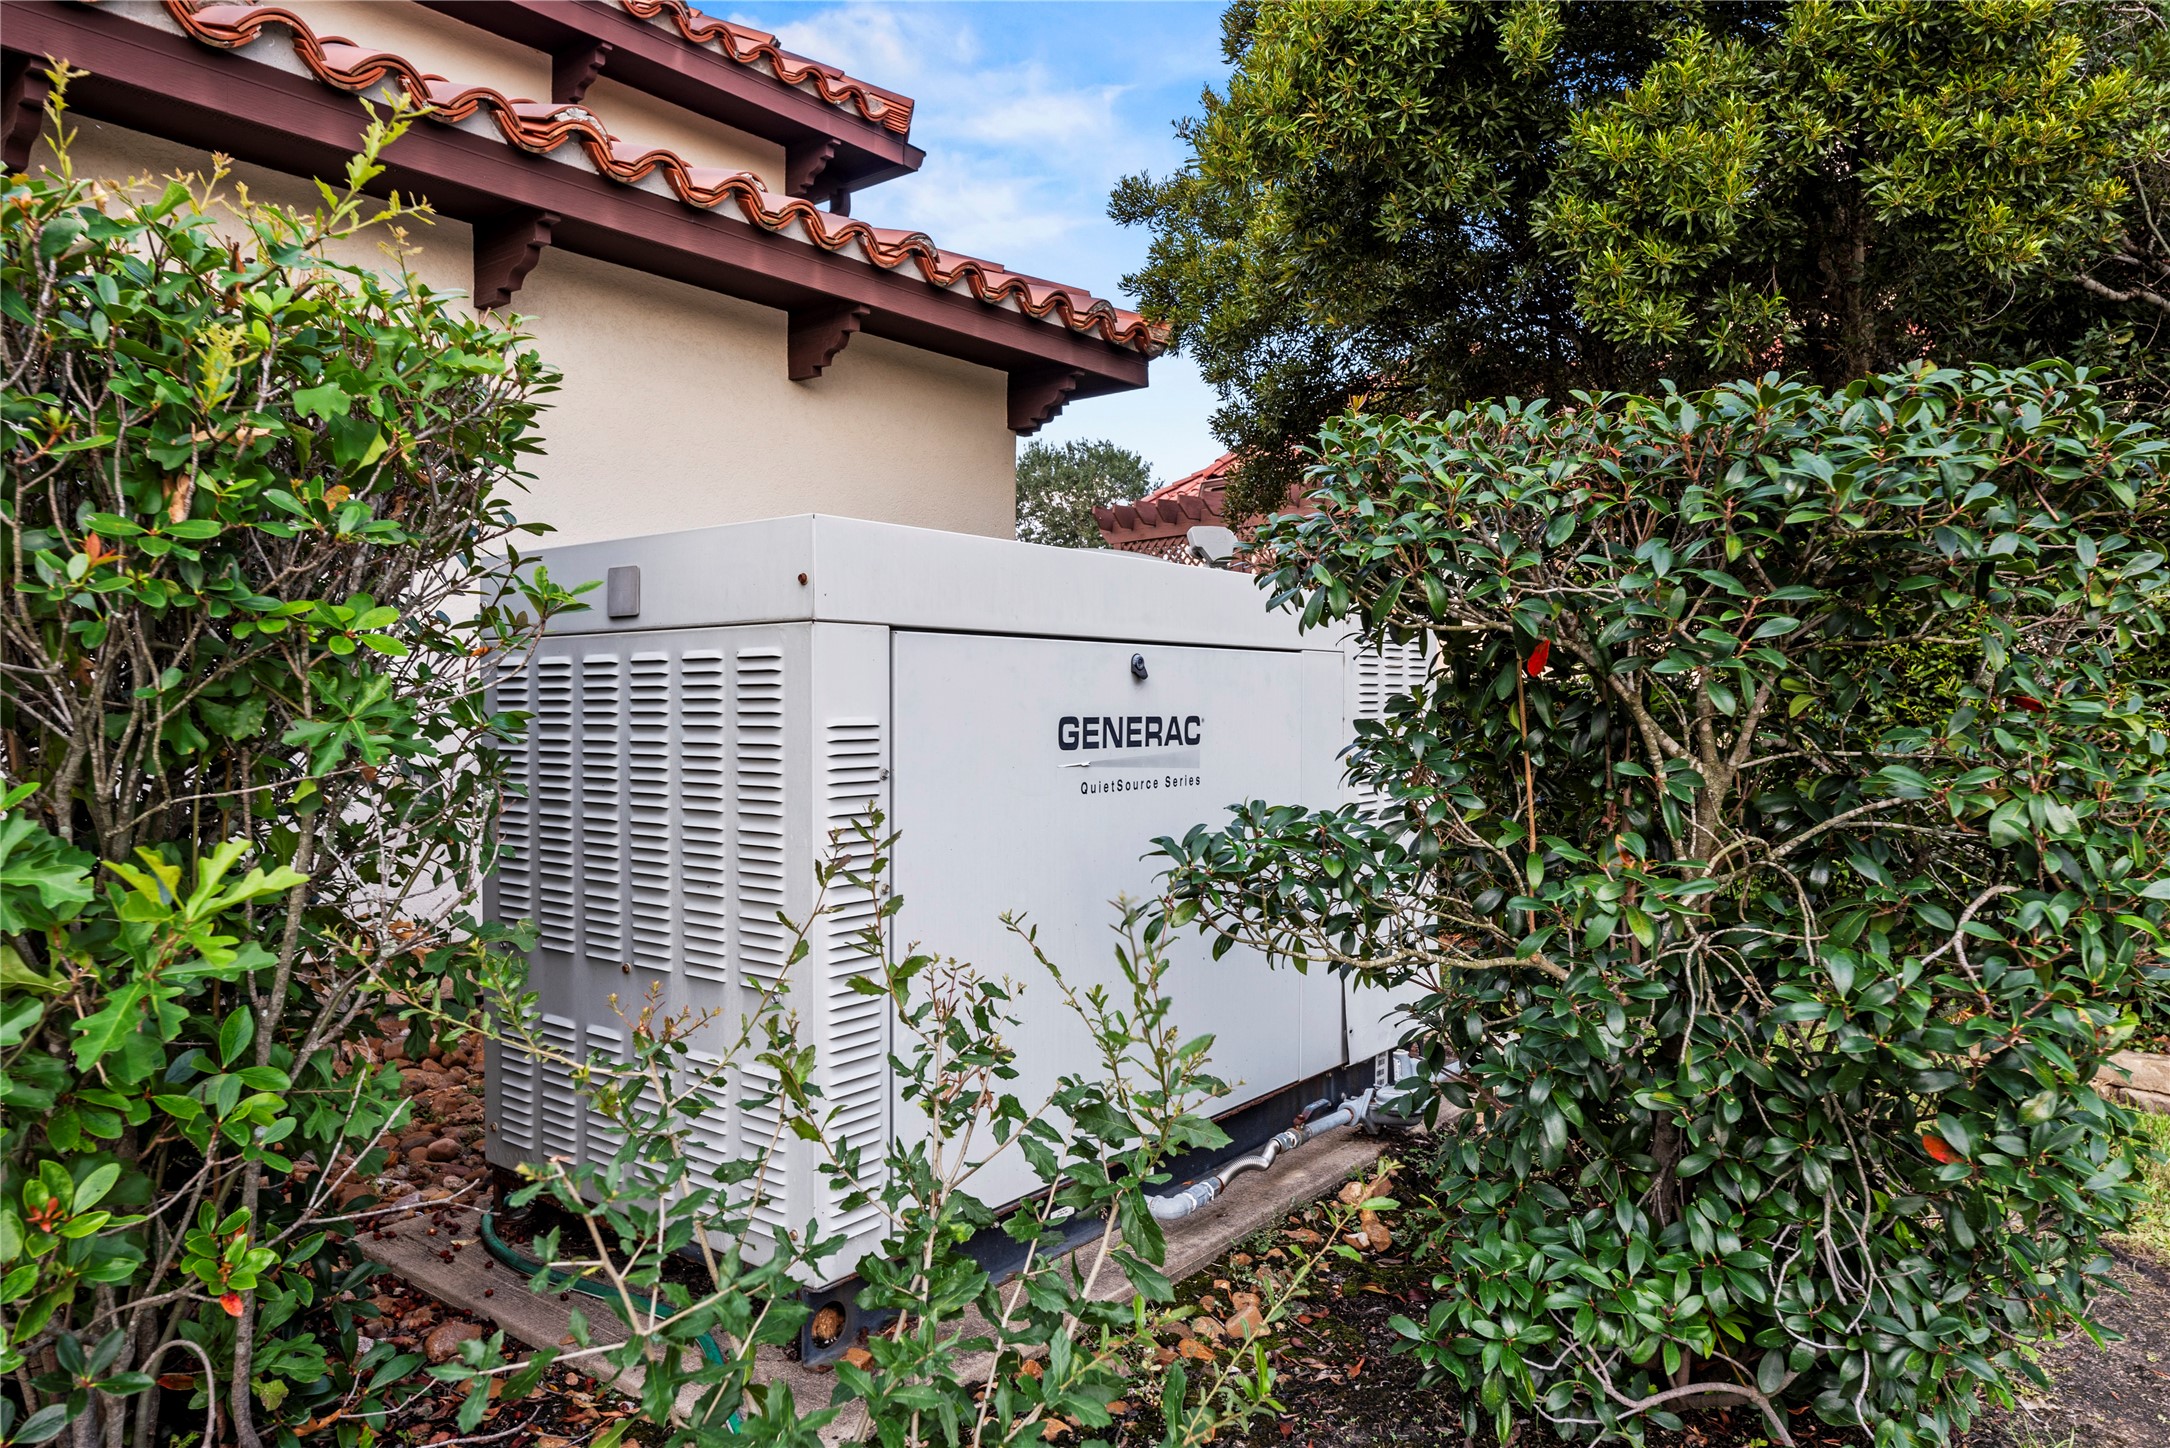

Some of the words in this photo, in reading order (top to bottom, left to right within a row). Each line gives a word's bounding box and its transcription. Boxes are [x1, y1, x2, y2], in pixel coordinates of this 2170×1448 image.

[1058, 715, 1201, 751] GENERAC
[1080, 779, 1159, 795] QuietSource
[1164, 775, 1201, 788] Series
